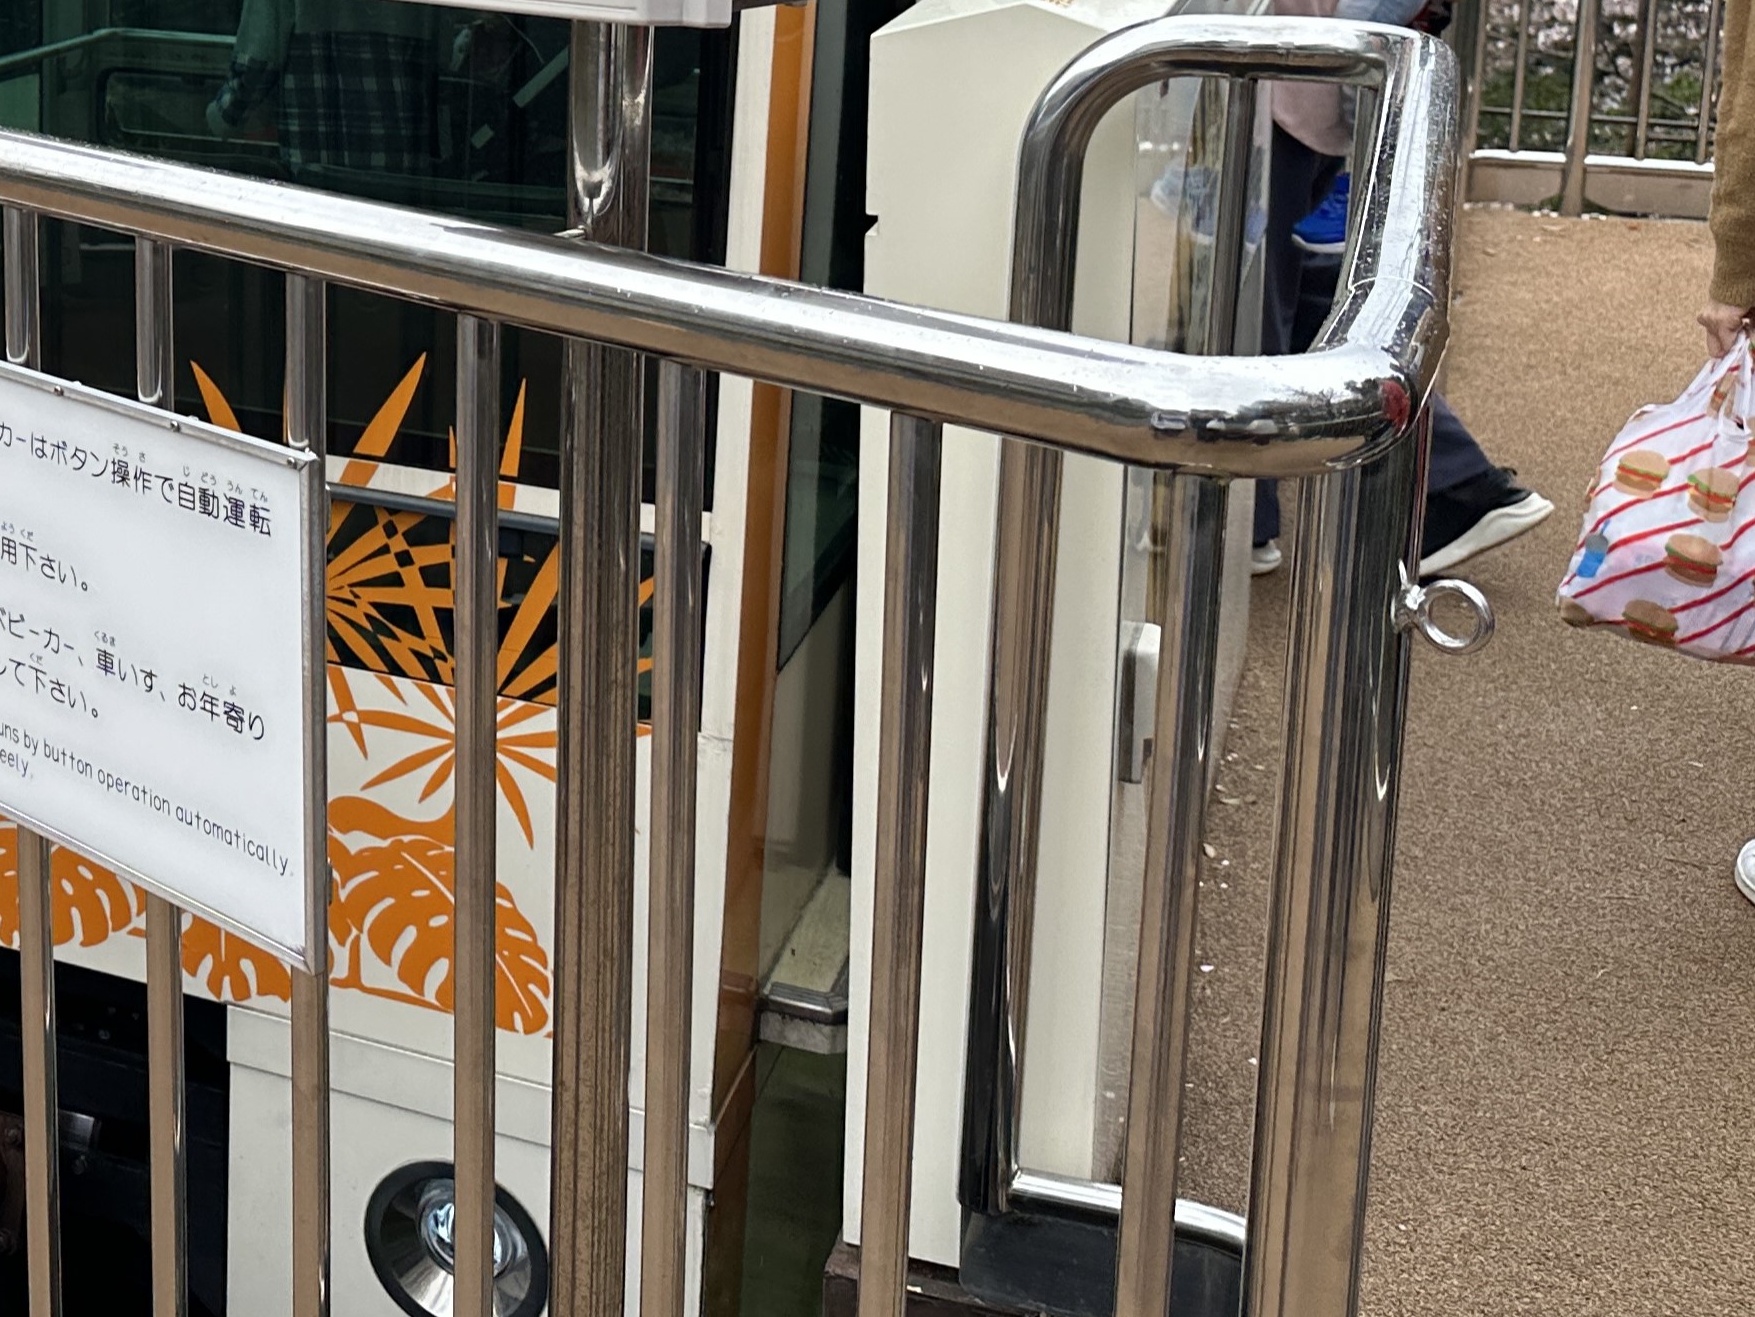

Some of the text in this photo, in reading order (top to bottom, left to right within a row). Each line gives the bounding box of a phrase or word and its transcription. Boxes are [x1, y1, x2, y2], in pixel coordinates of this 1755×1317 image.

[24, 729, 38, 756] by
[44, 738, 92, 779] button
[98, 769, 170, 816] operation
